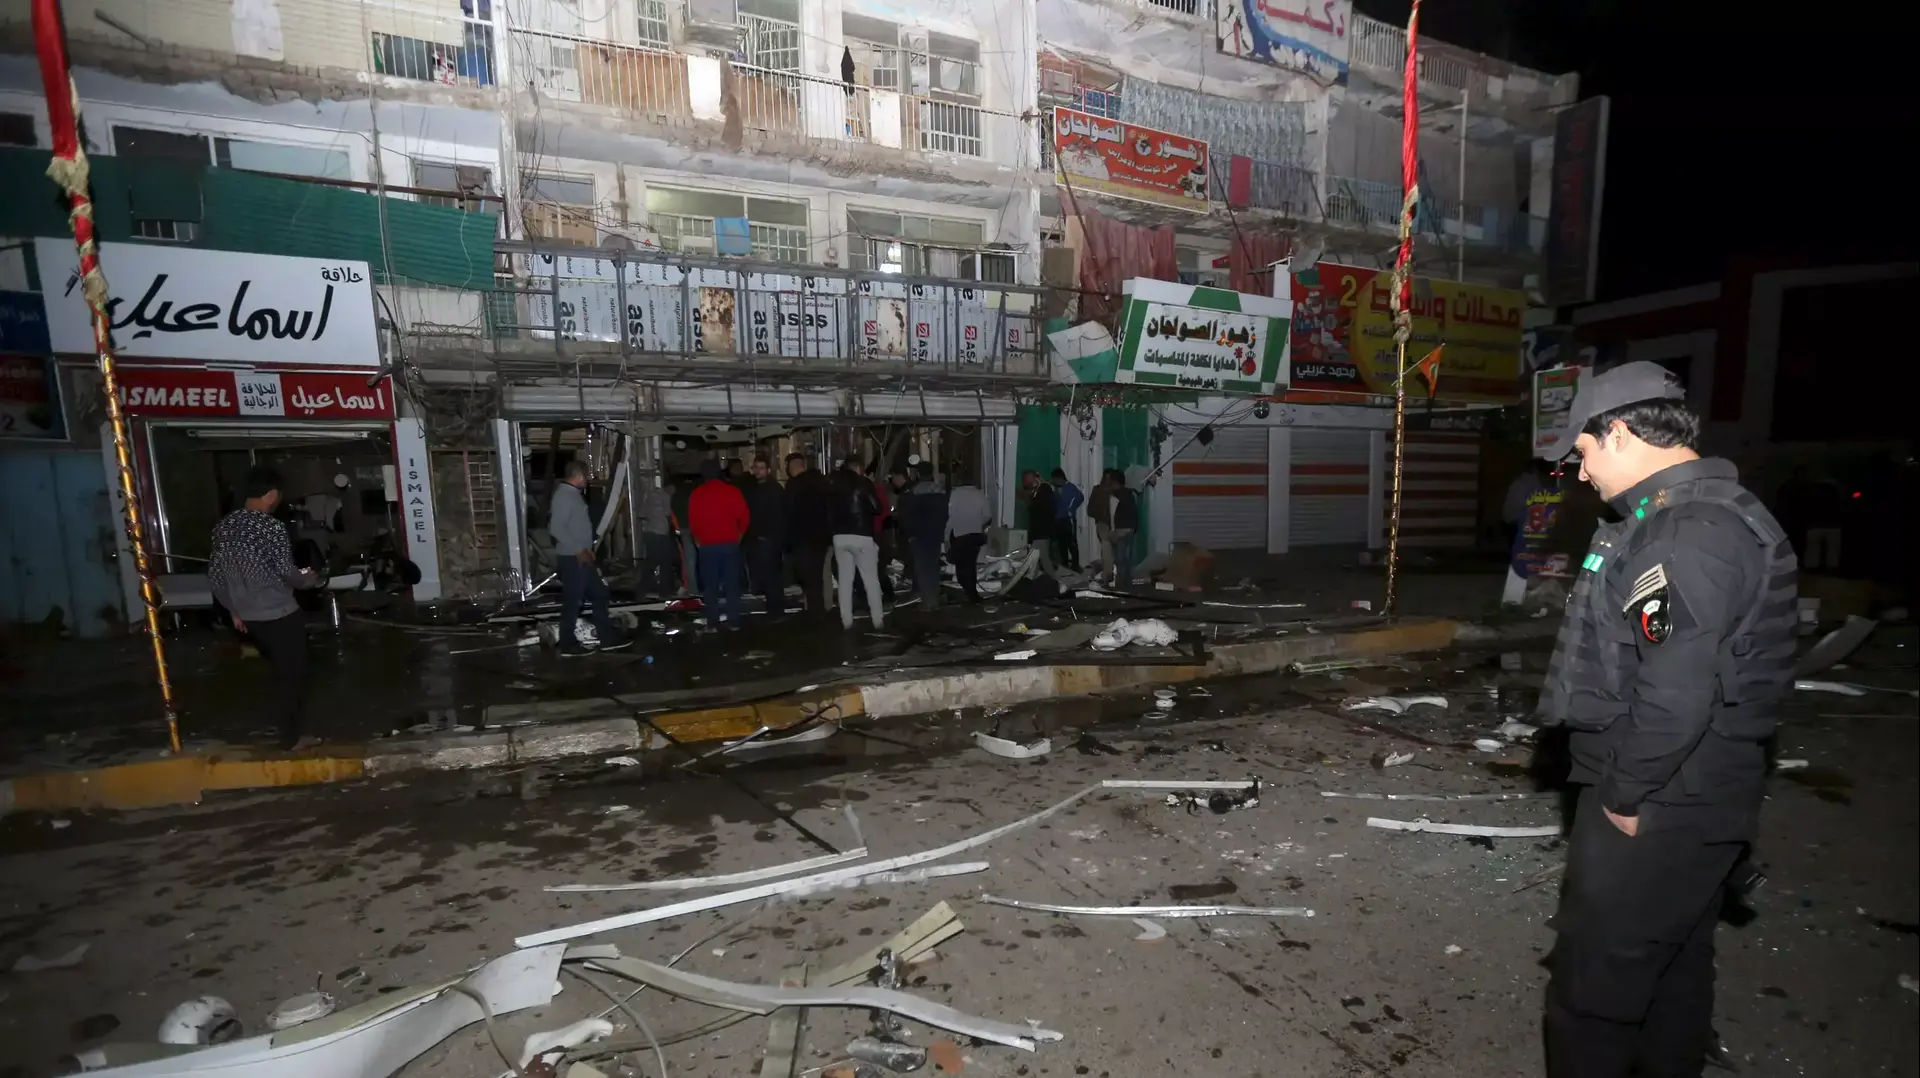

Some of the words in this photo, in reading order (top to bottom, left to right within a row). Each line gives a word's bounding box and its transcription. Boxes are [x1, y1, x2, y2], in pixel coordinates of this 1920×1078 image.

[1058, 113, 1125, 145] الصولجان
[321, 267, 363, 283] حلاقة
[1340, 274, 1357, 308] 2
[1453, 290, 1520, 328] محلات
[1146, 314, 1218, 343] الصولجان
[1216, 324, 1257, 350] زهور
[1327, 366, 1356, 379] محمد
[243, 395, 278, 409] الرجالية
[291, 385, 385, 415] اسماعيل
[408, 457, 427, 543] ISMAEEL
